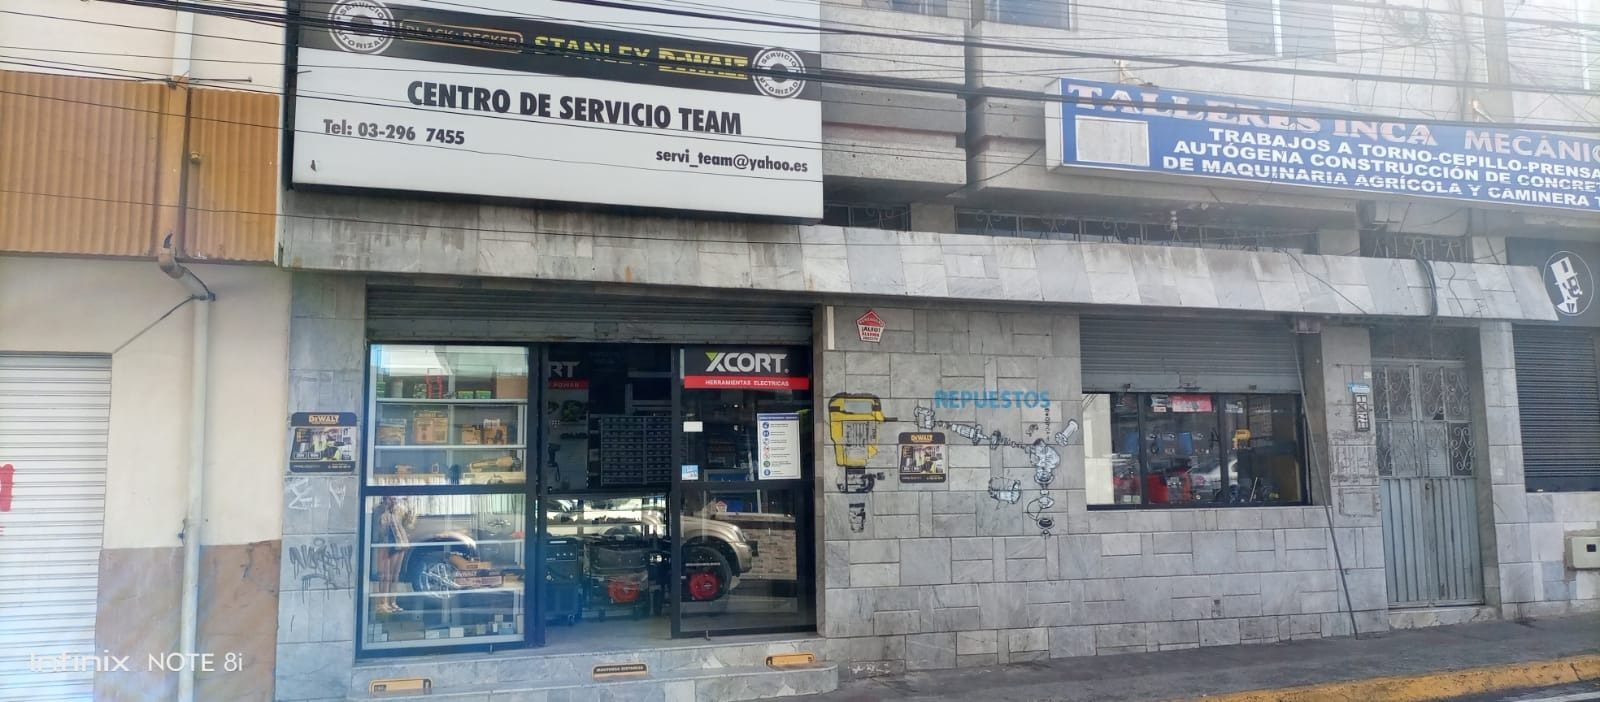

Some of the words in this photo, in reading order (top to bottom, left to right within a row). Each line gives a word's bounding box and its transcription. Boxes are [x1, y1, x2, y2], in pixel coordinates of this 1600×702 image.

[761, 52, 797, 67] SERVICIO
[757, 76, 799, 95] UTORIZAD
[407, 80, 511, 113] CENTRO
[519, 91, 551, 118] DE
[559, 95, 671, 130] SERVICIO
[678, 107, 742, 135] TEAM
[1067, 84, 1321, 134] TALLERES
[1332, 118, 1439, 148] INCA
[323, 118, 353, 136] Tel:
[357, 121, 416, 141] 03-296
[426, 127, 465, 145] 7455
[1208, 128, 1331, 152] TRABAJOS
[1338, 142, 1353, 155] A
[655, 148, 809, 173] servi_team@yahoo.es
[1174, 140, 1304, 165] AUTÓGENA
[1310, 153, 1480, 182] CONSTRUCCIÓN
[1485, 171, 1511, 185] DE
[1163, 156, 1195, 172] DE
[1201, 158, 1348, 185] MAQUINARIA
[1354, 171, 1463, 195] AGRÍCOLA
[1467, 184, 1483, 198] Y
[1487, 187, 1590, 206] CAMINERA
[935, 389, 1052, 409] REPUESTOS
